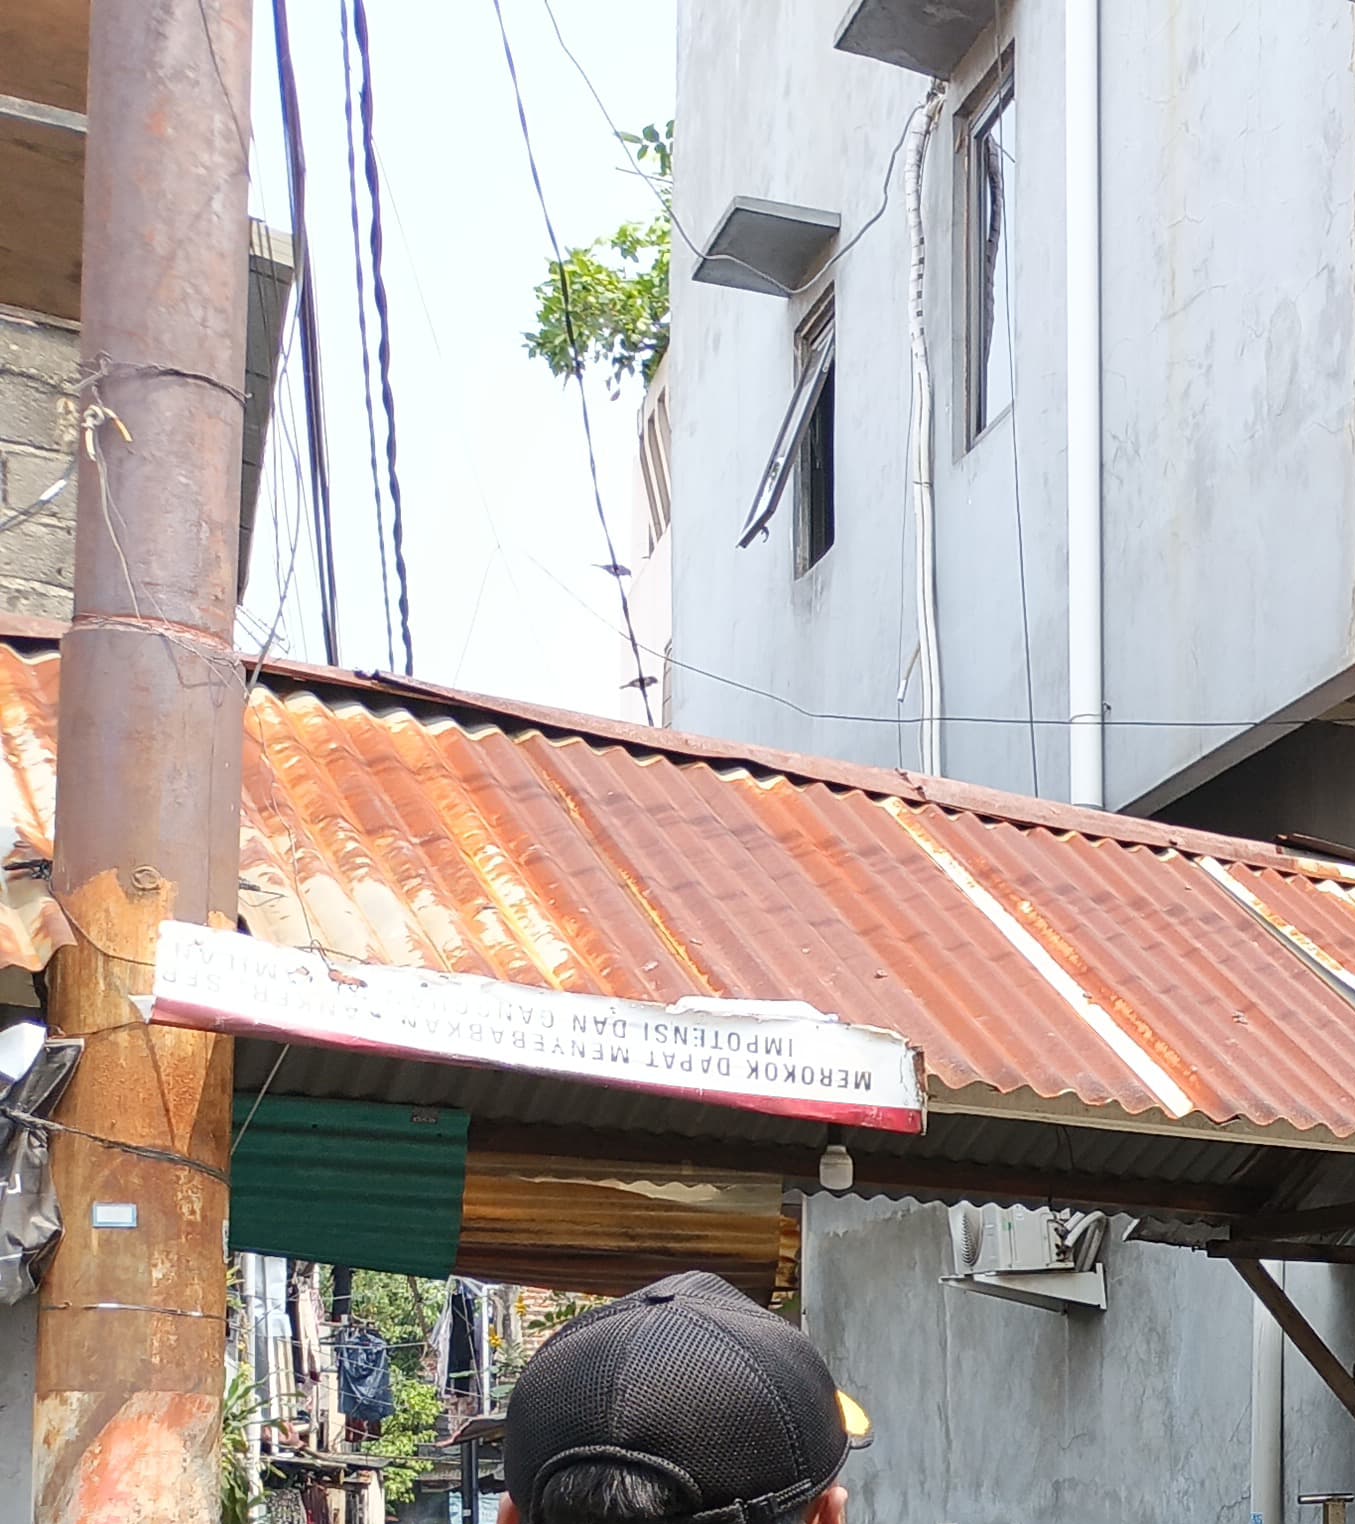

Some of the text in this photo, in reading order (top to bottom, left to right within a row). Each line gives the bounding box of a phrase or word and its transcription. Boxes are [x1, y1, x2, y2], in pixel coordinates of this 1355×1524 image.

[572, 1012, 627, 1040] DAN
[644, 1022, 793, 1058] IMPOTENSI
[646, 1051, 731, 1077] DAPAT
[745, 1058, 874, 1092] MEROKOK
